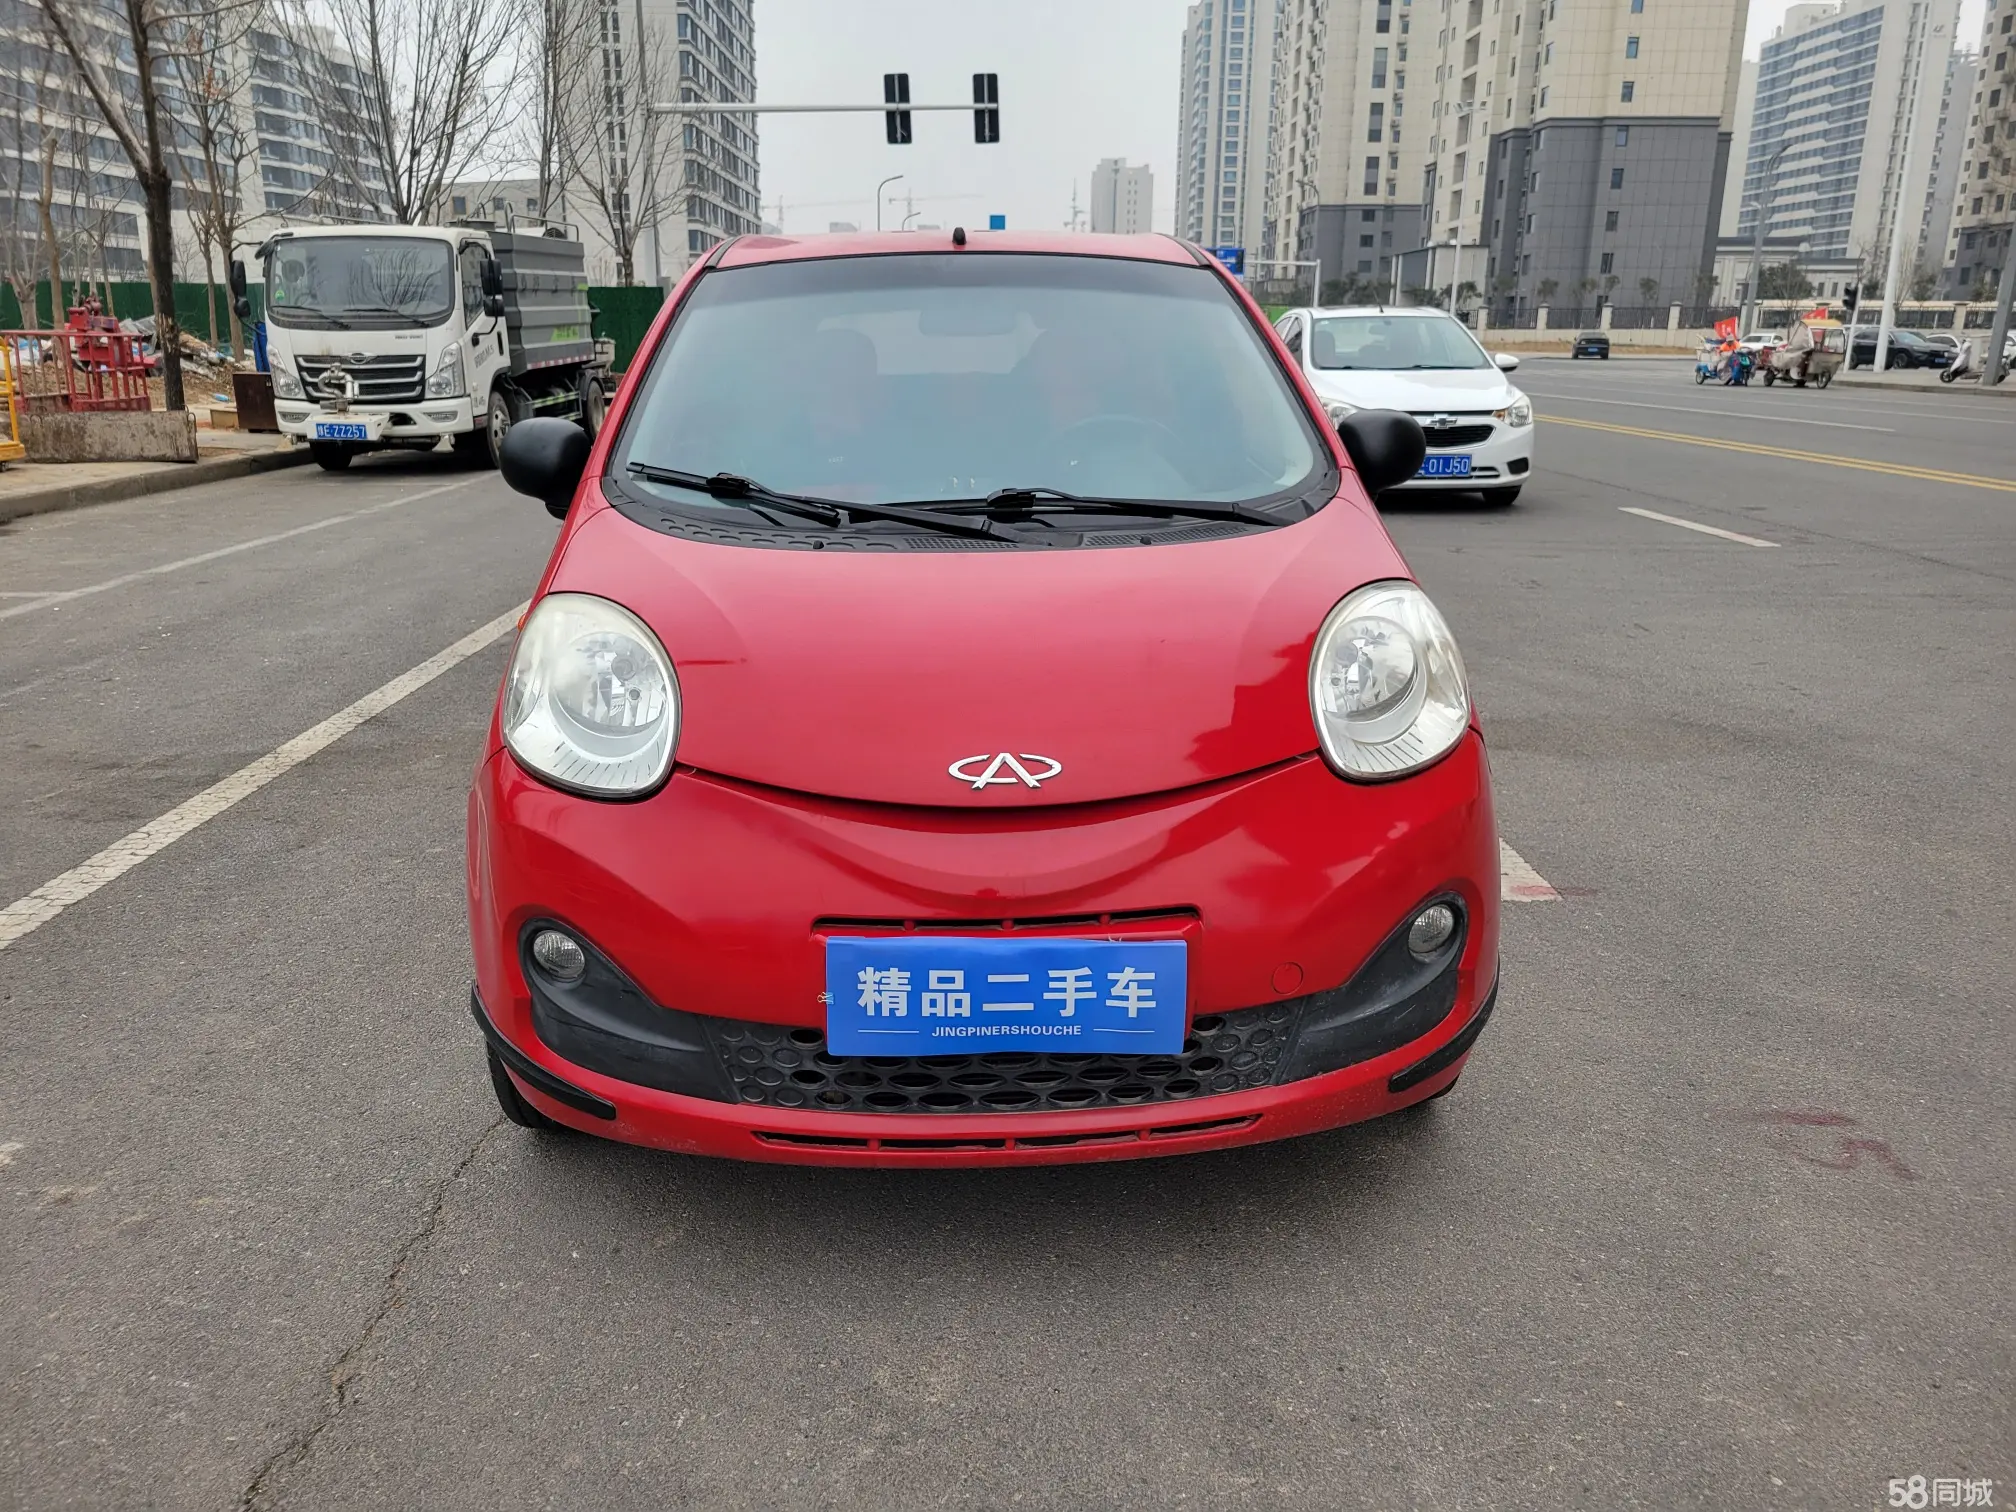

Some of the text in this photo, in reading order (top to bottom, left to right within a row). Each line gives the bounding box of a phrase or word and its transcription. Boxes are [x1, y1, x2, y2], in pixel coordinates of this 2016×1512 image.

[857, 966, 1158, 1018] 精品二手车
[931, 1024, 1082, 1038] JINGPINERSHOUCHE
